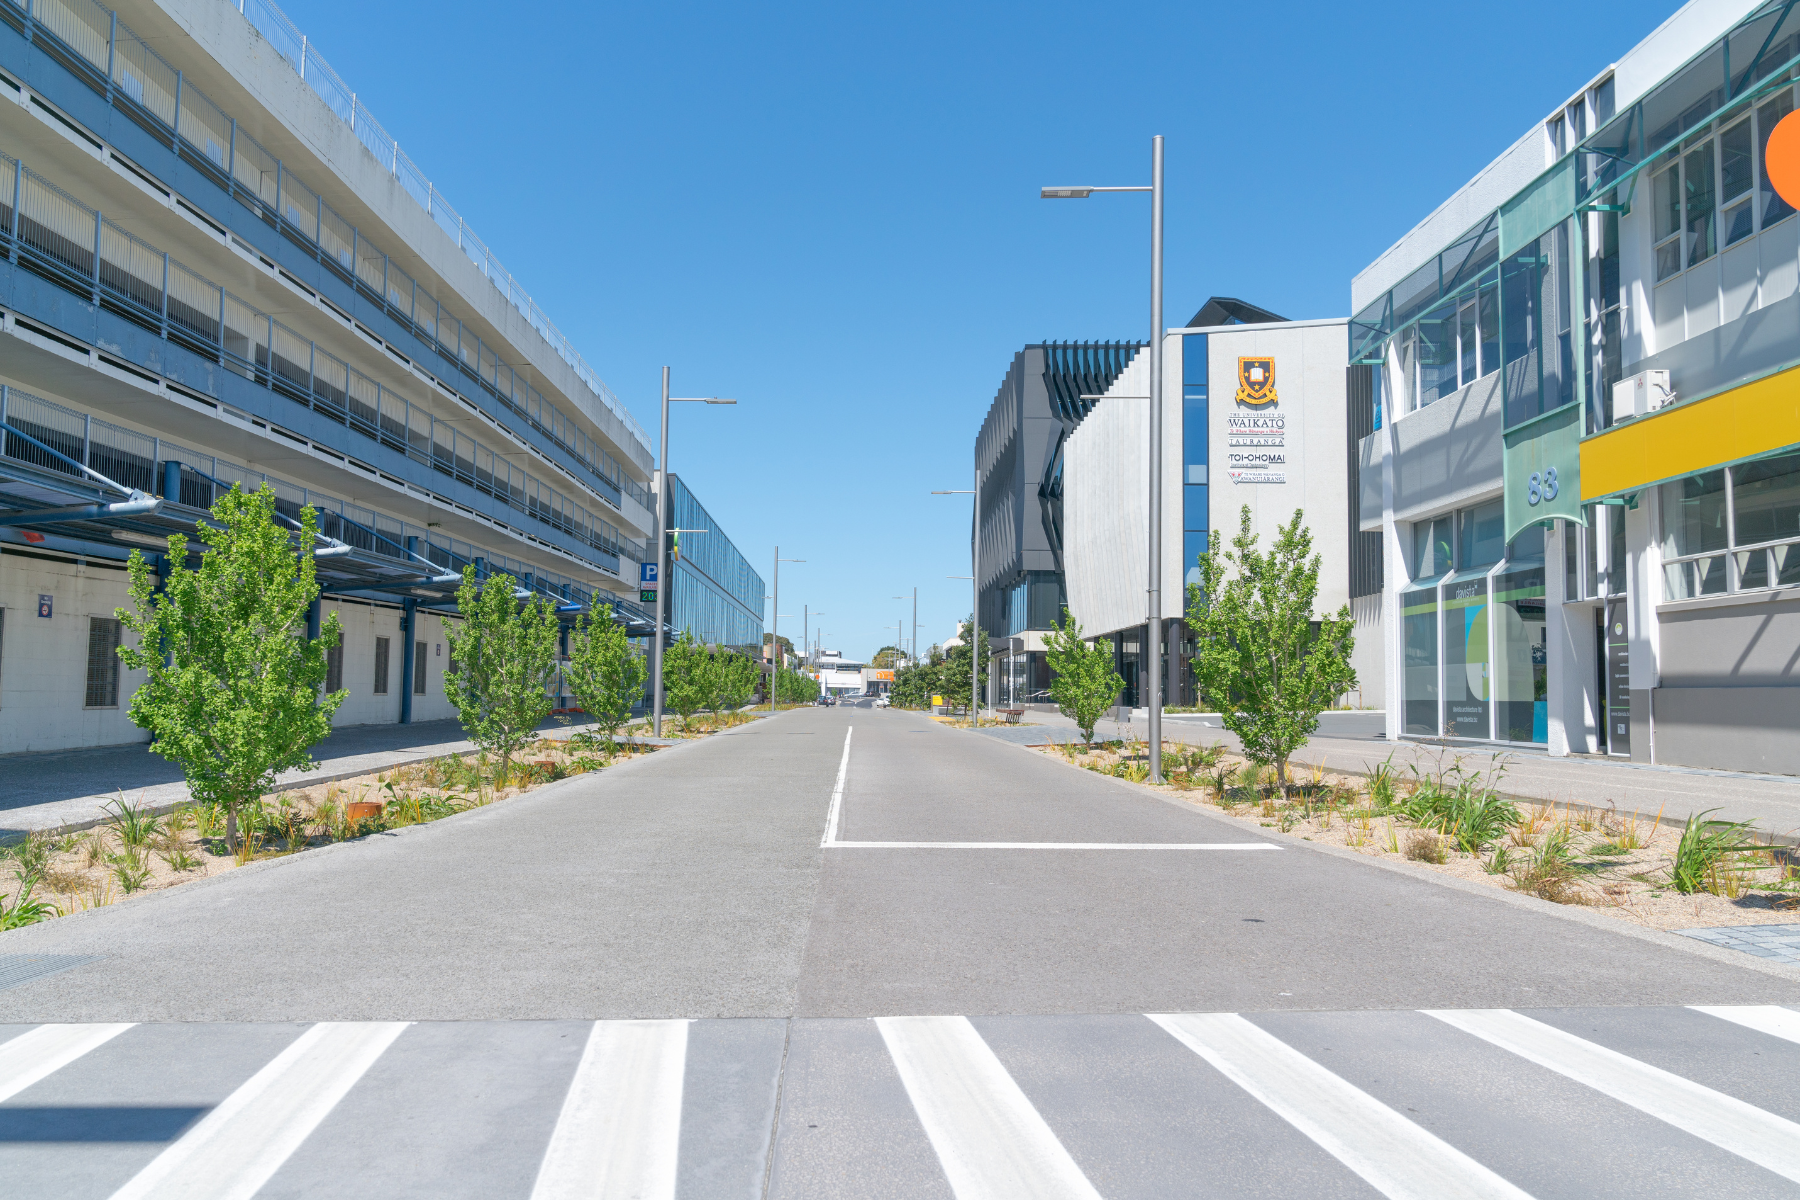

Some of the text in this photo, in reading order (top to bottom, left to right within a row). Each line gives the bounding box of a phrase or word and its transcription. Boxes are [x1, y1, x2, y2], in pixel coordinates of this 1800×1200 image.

[1228, 419, 1285, 427] WAIKATO
[1528, 466, 1559, 505] 83
[646, 565, 657, 579] P
[1456, 585, 1475, 599] davista
